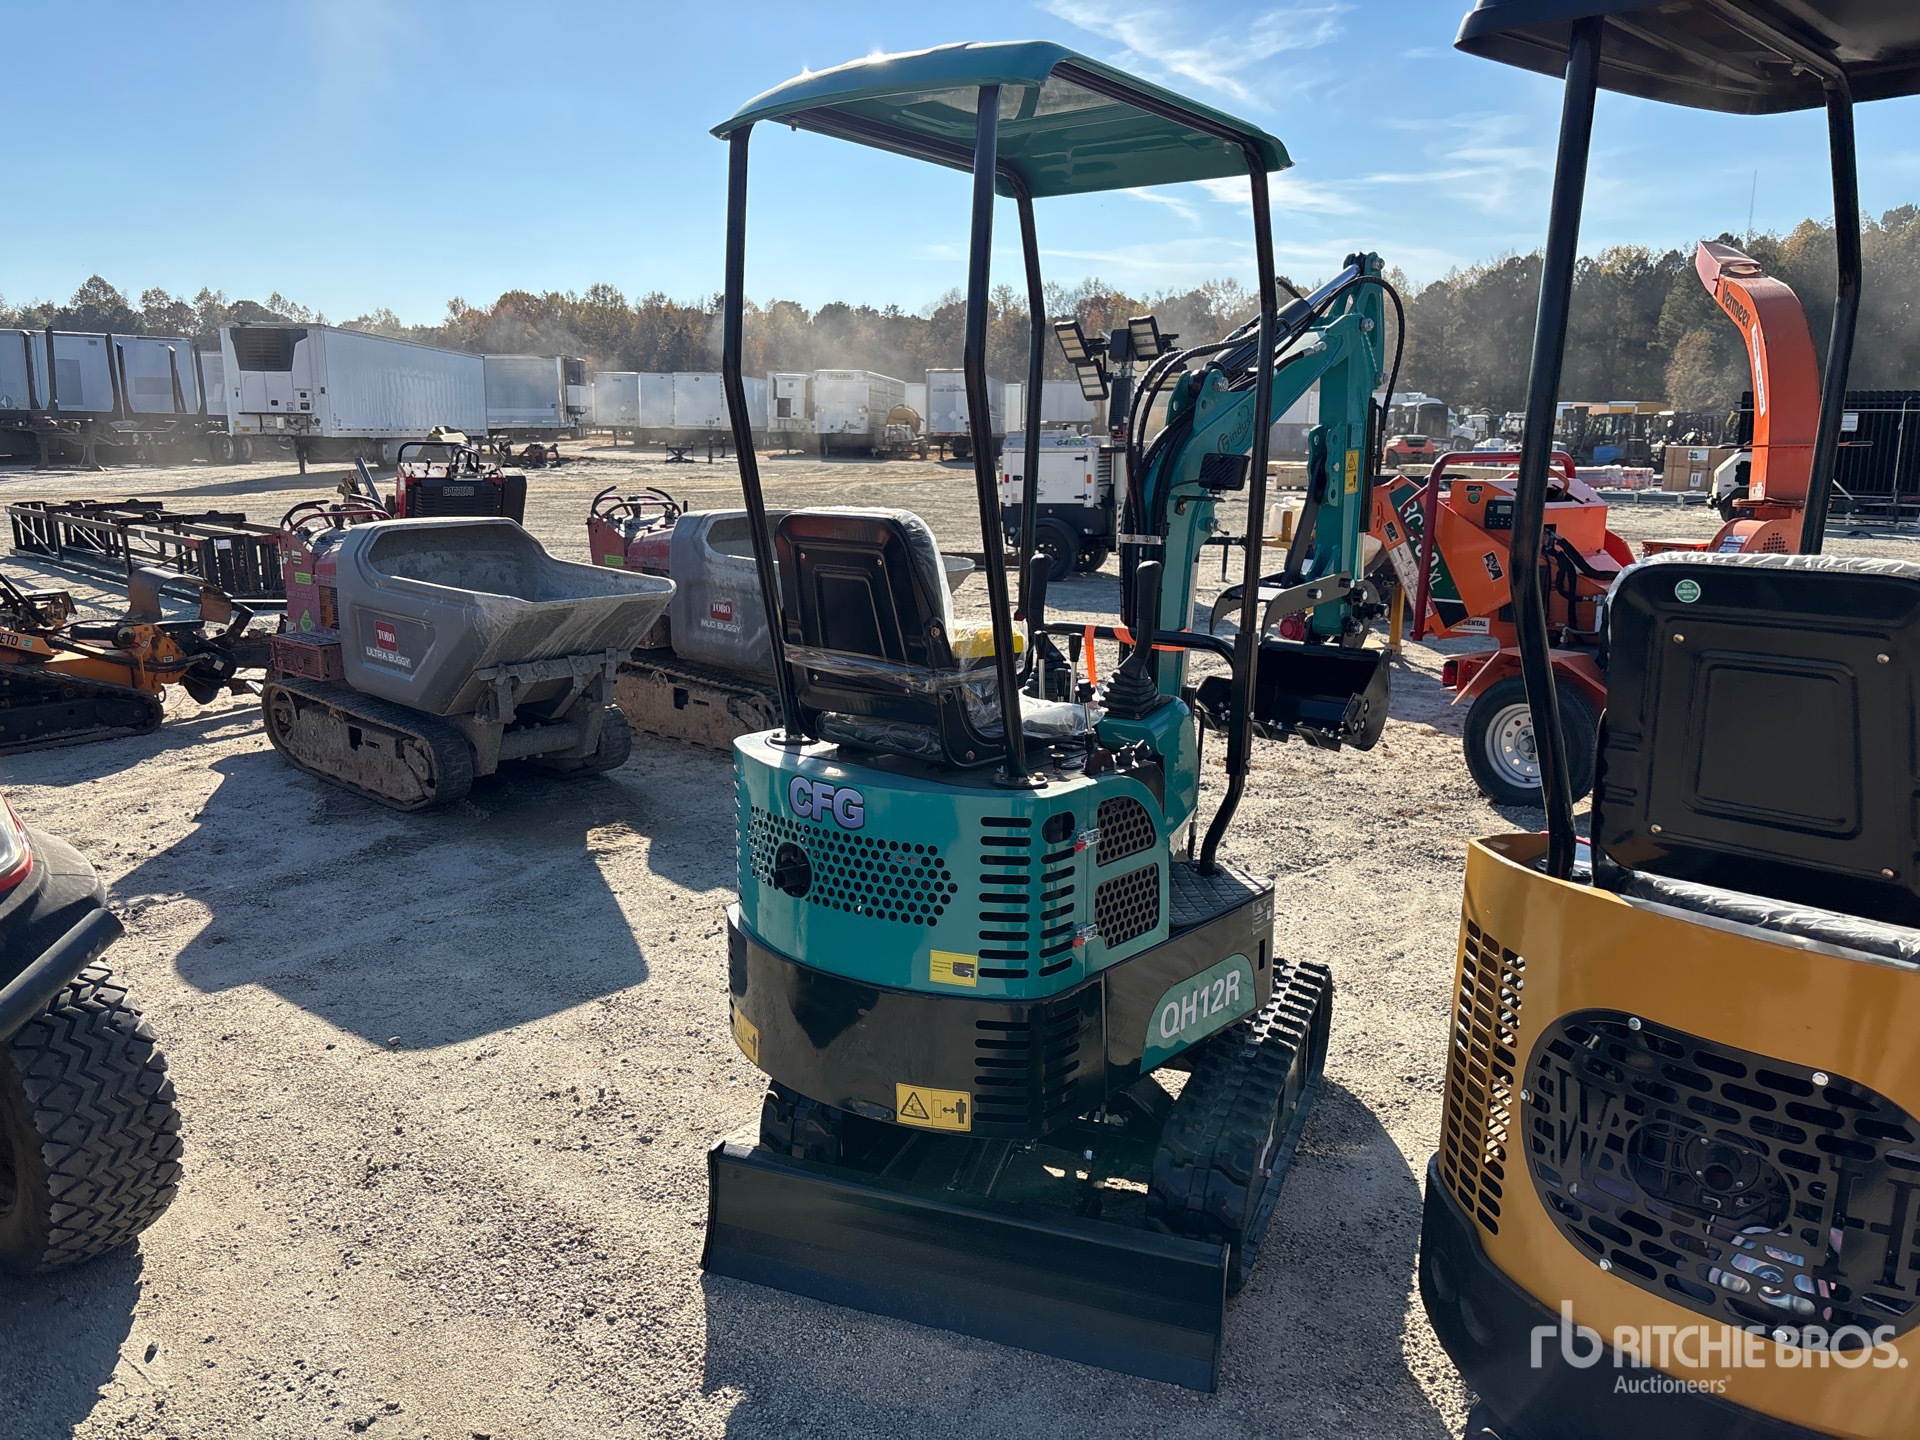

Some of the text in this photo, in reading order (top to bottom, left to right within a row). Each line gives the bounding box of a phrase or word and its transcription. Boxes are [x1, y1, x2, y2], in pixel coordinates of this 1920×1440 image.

[1722, 281, 1750, 329] Vermeer
[377, 629, 396, 643] TORO
[701, 619, 742, 633] MUD BUGGY
[0, 633, 19, 646] ETO
[366, 646, 412, 668] ULTRA BUGGY
[788, 775, 865, 829] CFG
[1160, 969, 1241, 1039] QH12R
